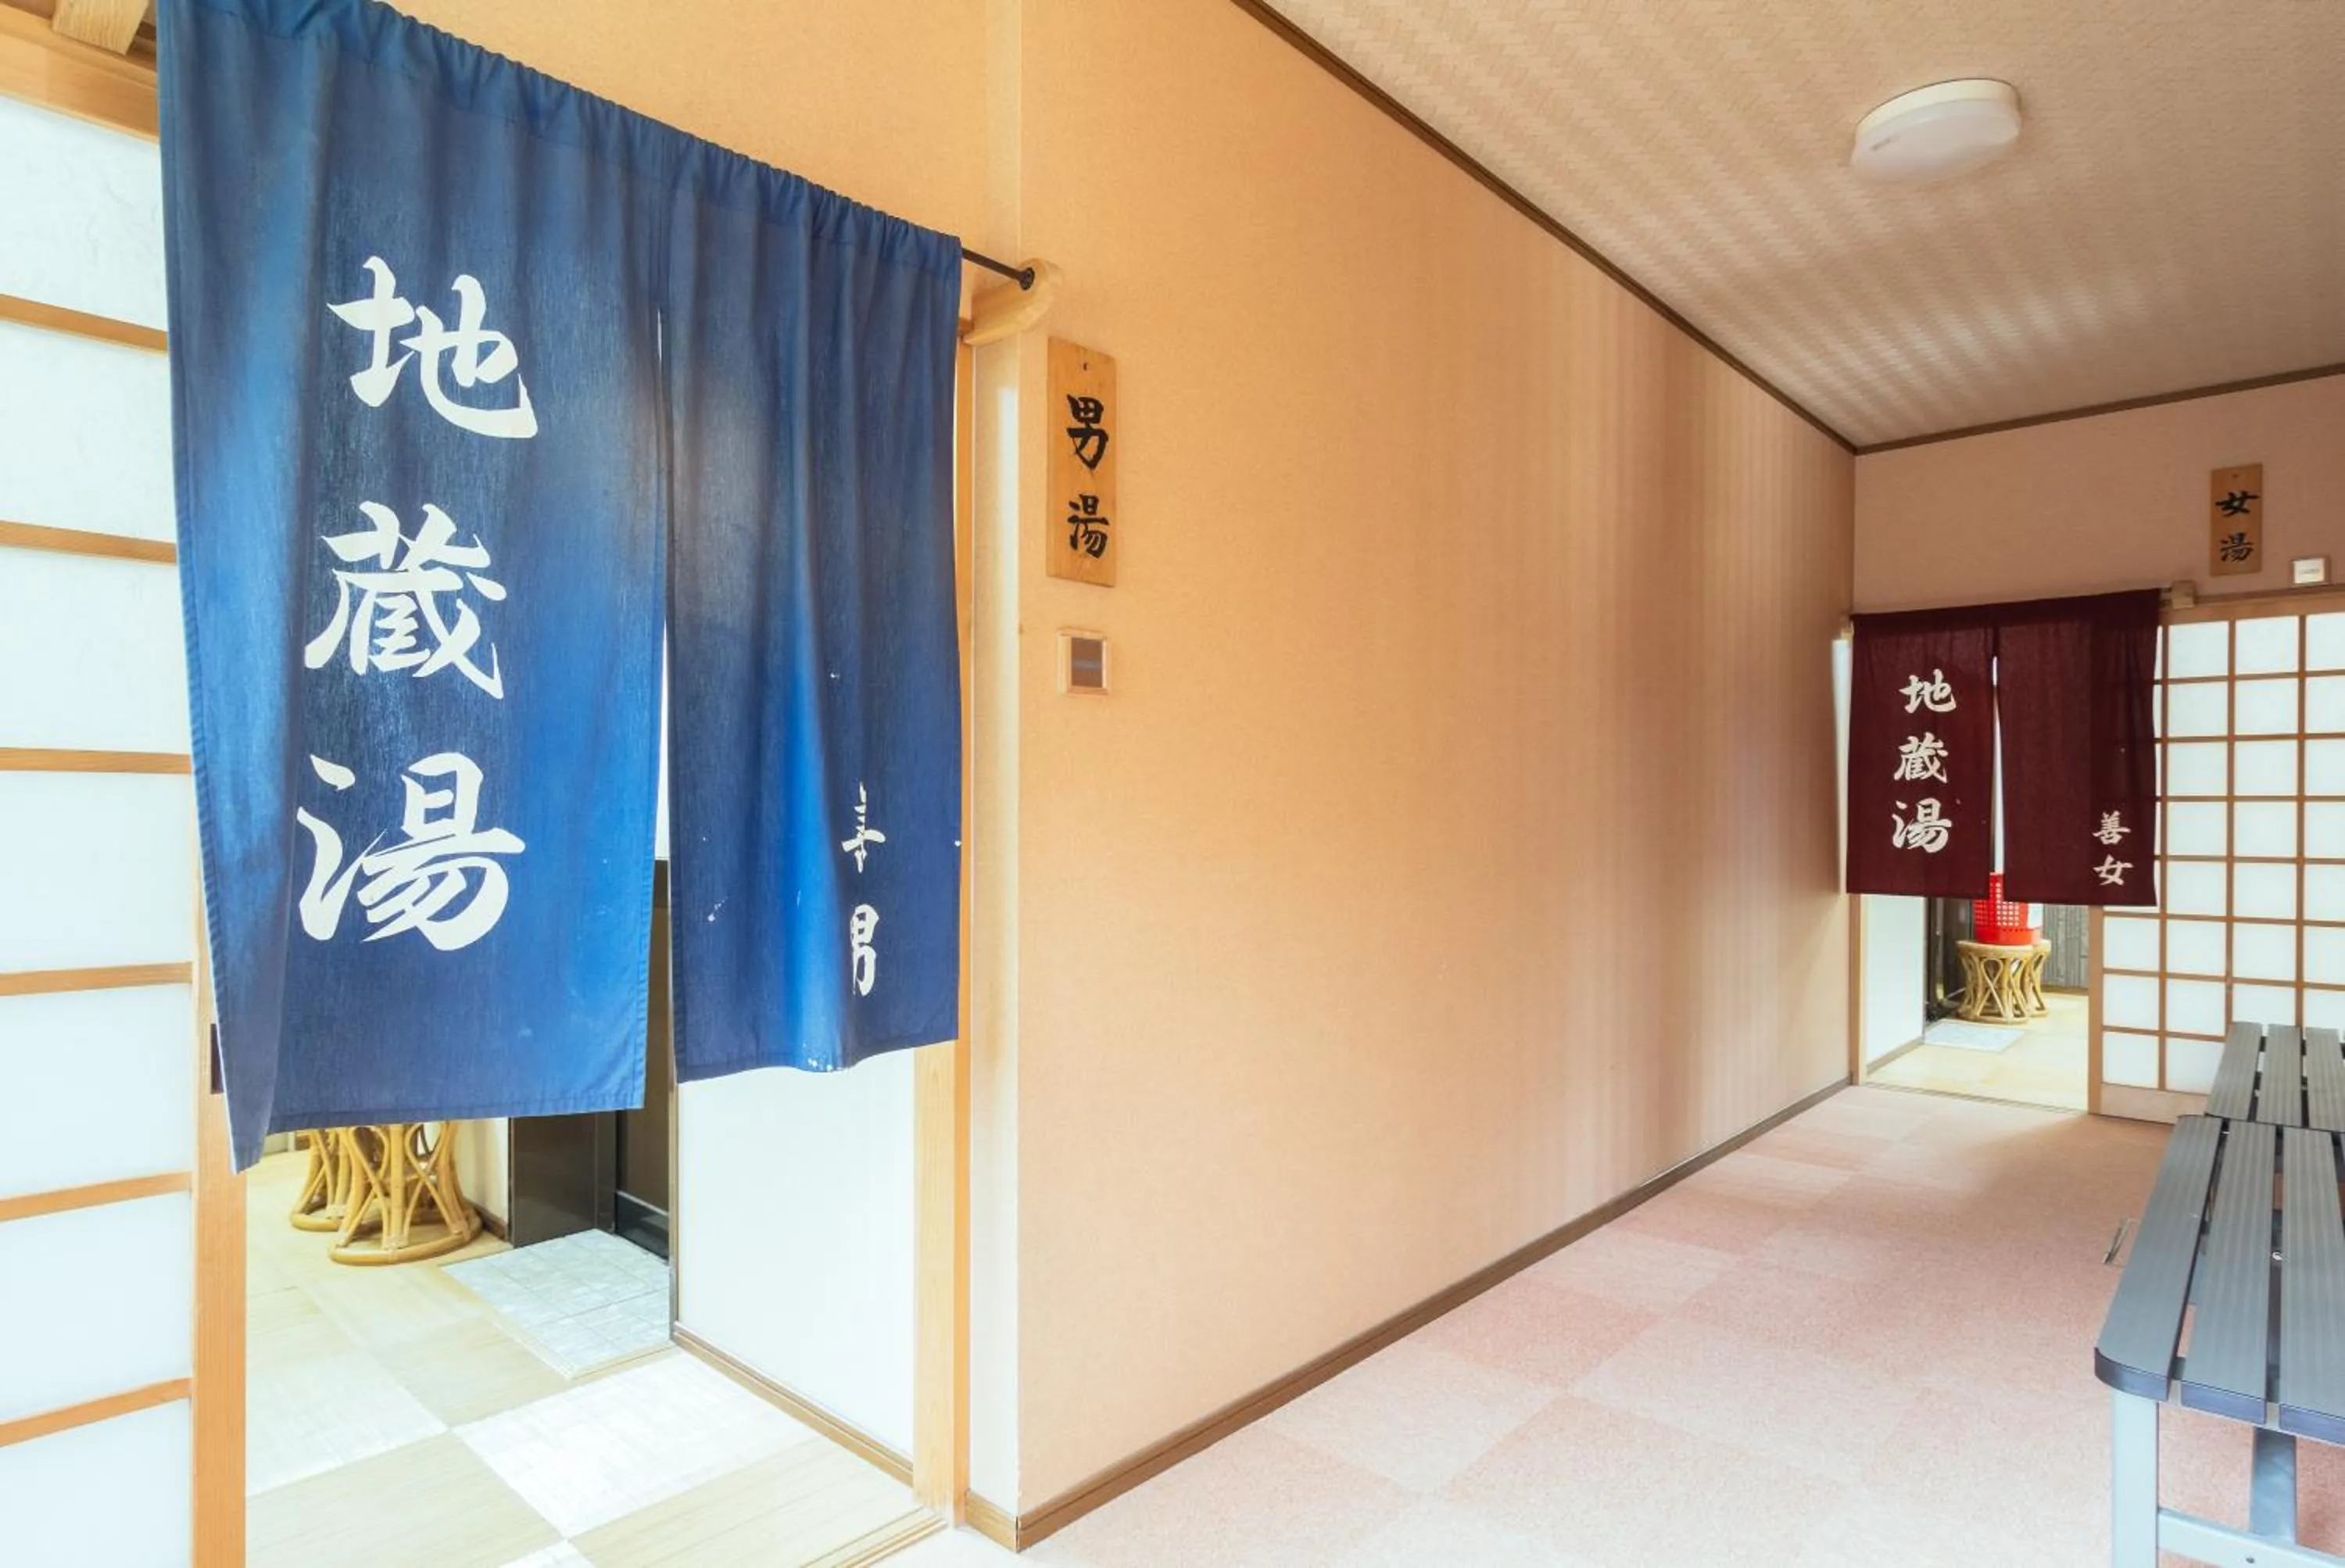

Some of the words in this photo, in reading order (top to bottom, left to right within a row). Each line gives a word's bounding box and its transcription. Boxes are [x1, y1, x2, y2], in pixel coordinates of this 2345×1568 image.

[1065, 393, 1110, 560] 男湯
[2214, 489, 2261, 564] 女湯
[297, 256, 539, 950] 地蔵湯
[1891, 668, 1957, 854] 地蔵湯
[2092, 810, 2134, 886] 善女
